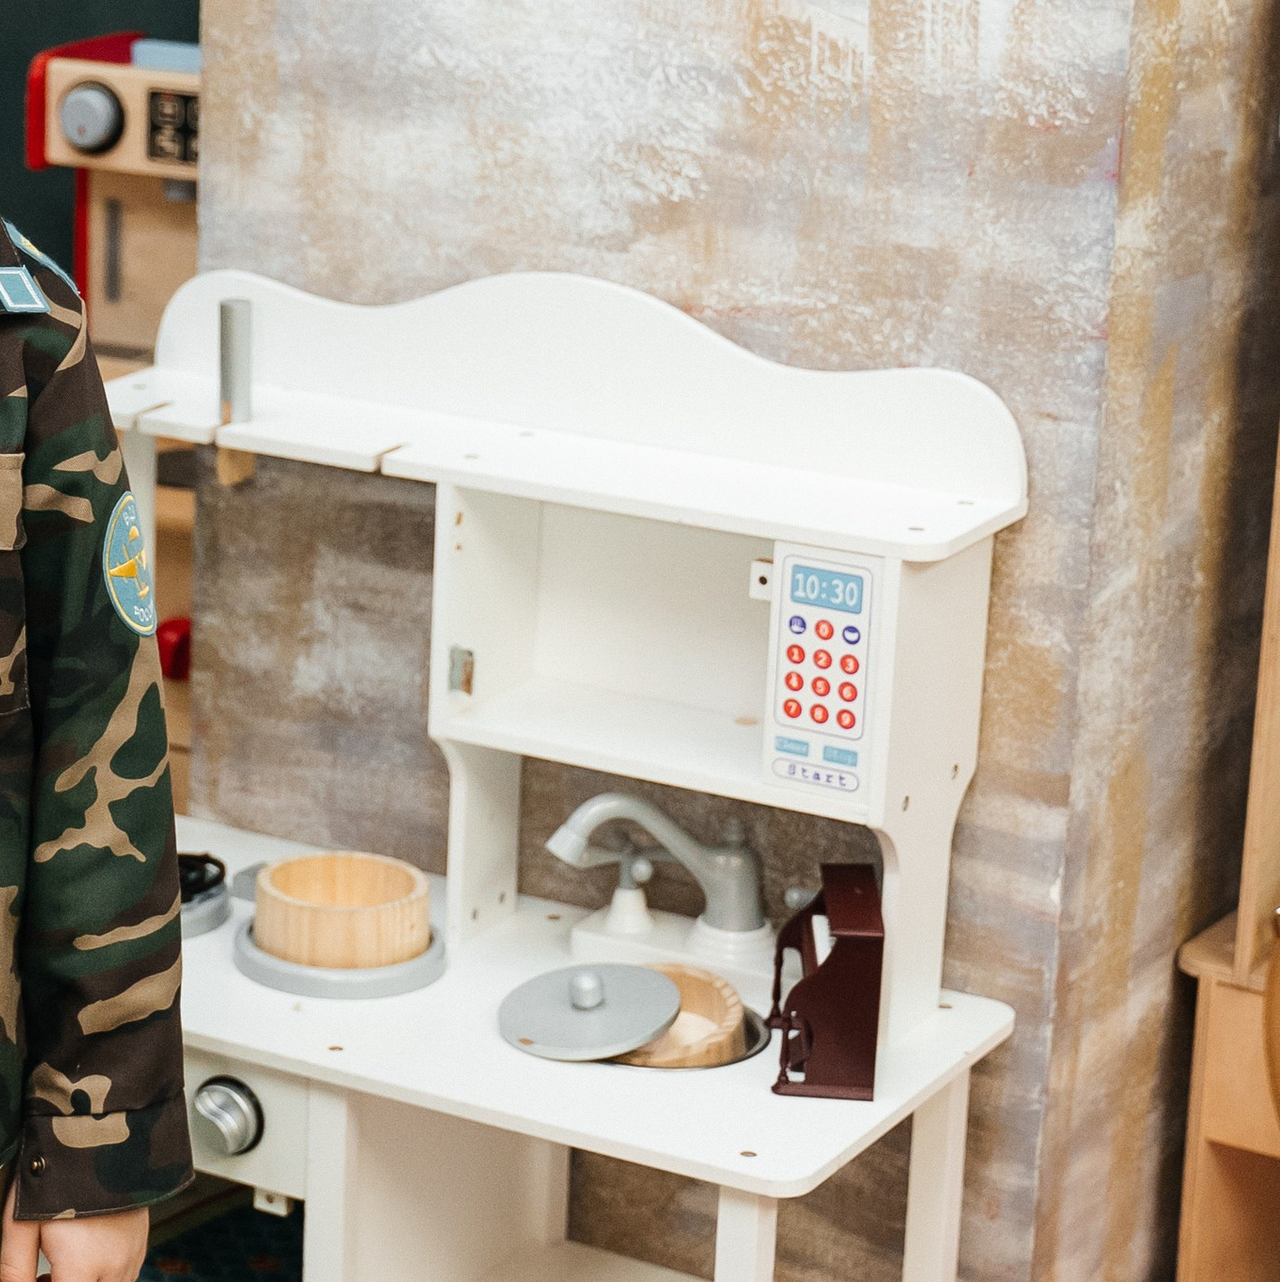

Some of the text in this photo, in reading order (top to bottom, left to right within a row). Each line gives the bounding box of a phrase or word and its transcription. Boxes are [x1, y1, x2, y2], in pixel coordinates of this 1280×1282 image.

[794, 573, 859, 607] 10:30
[817, 651, 827, 666] 2
[844, 657, 855, 672] 3
[788, 673, 799, 688] 4
[815, 679, 826, 694] 5
[786, 701, 797, 715] 7
[787, 763, 847, 787] Start
